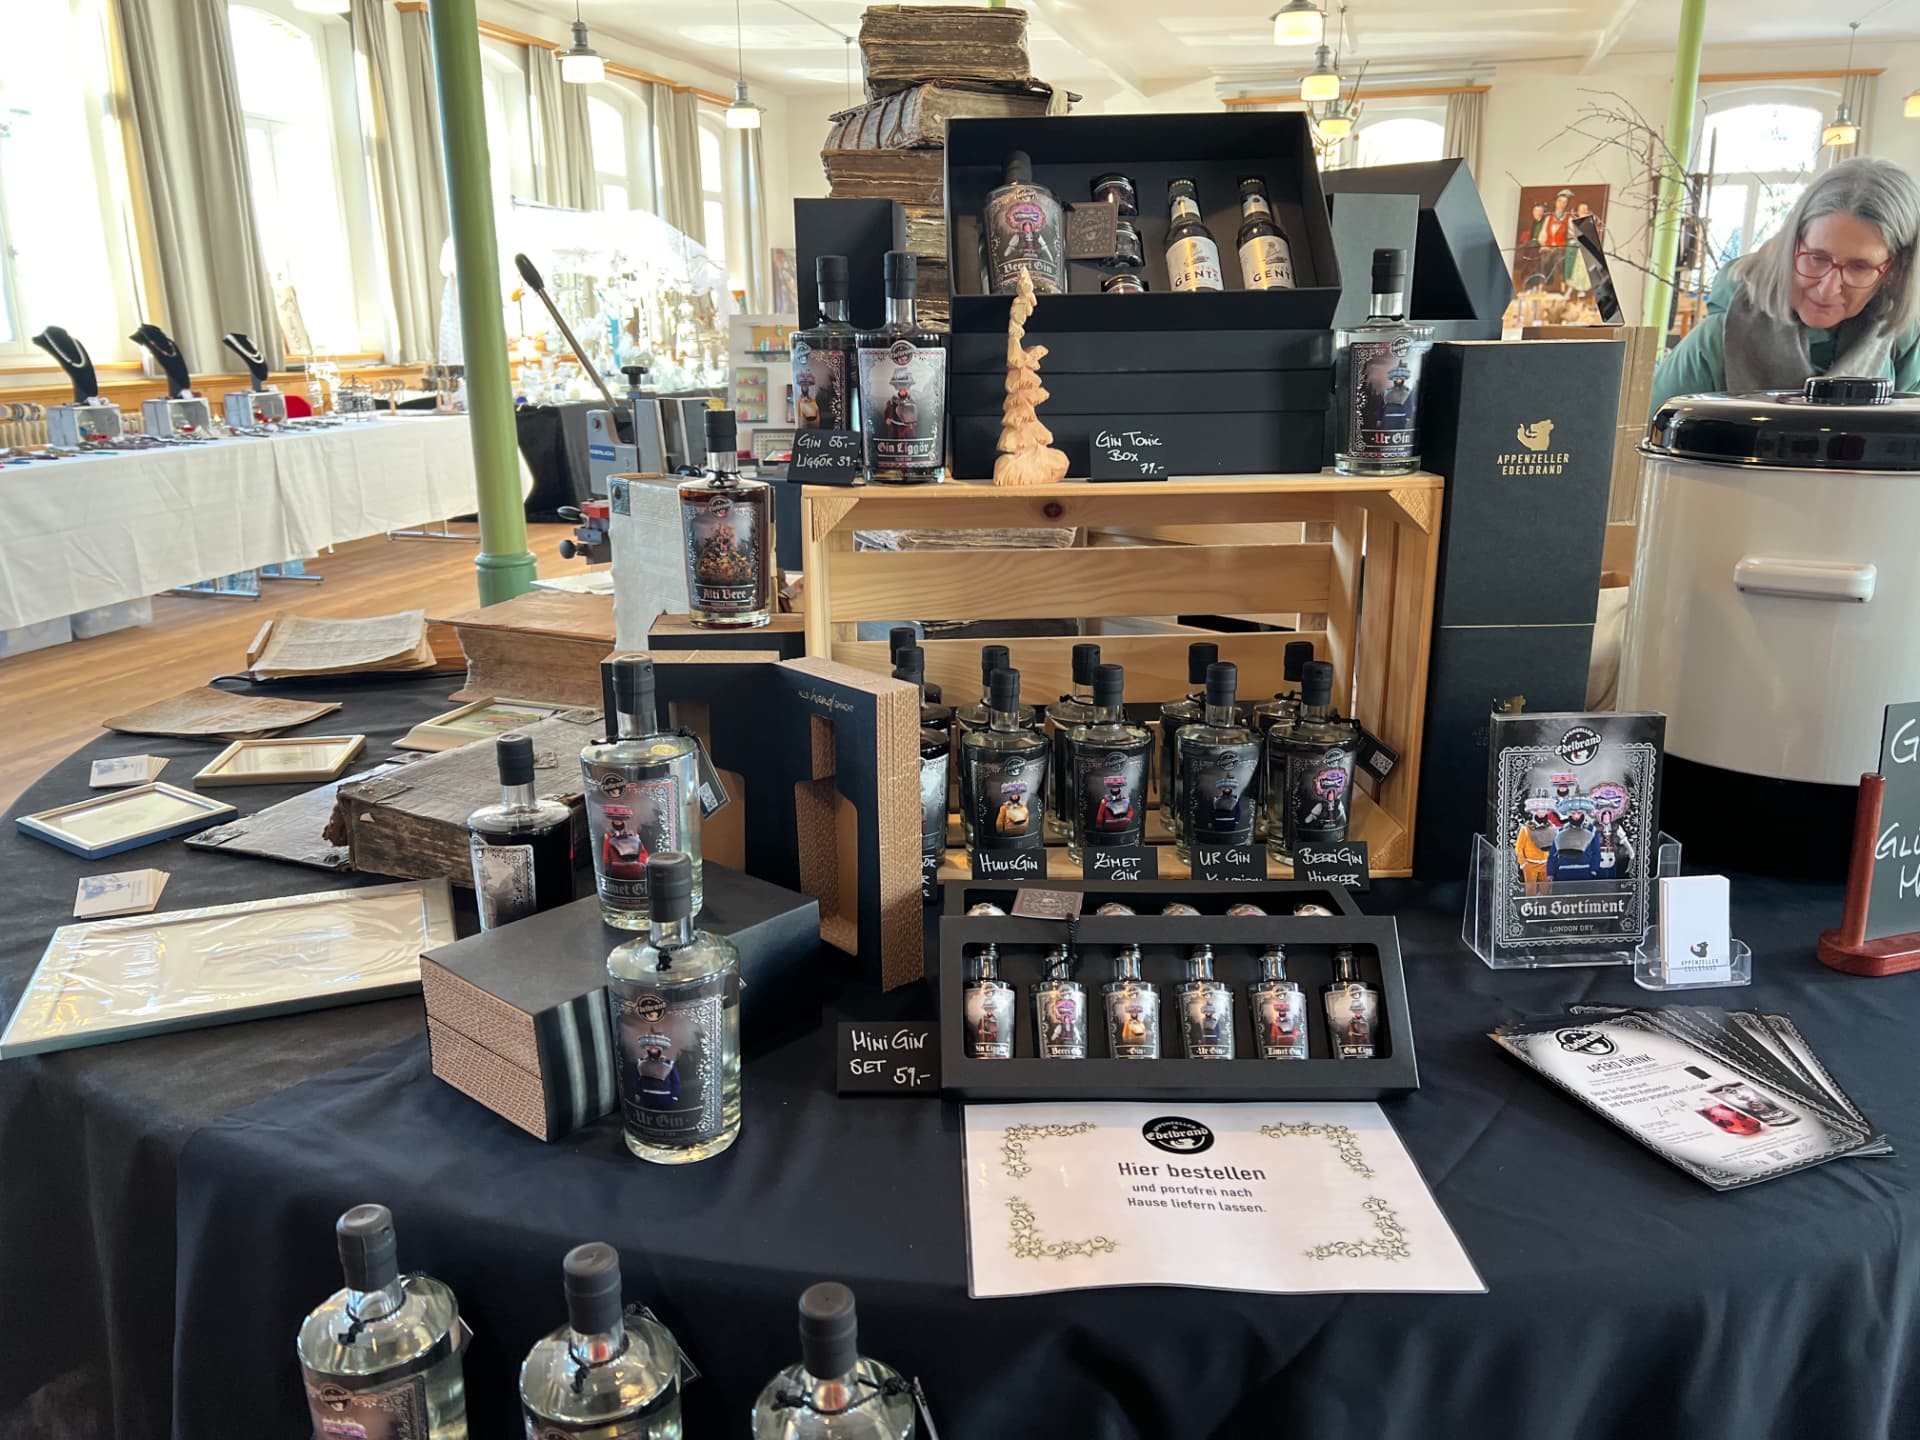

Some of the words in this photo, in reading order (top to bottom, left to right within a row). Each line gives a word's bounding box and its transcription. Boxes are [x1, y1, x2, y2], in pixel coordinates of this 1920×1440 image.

[1033, 261, 1053, 273] Gin
[1253, 269, 1295, 283] GENT
[877, 442, 895, 454] Gin
[897, 442, 929, 455] Liggör
[1496, 452, 1570, 465] APPENZELLER
[1502, 464, 1563, 476] EDELBRAND
[1554, 733, 1603, 755] Edelbrand
[631, 882, 648, 896] Gi
[1520, 901, 1547, 917] Gin
[1550, 898, 1625, 915] Sortiment
[1549, 924, 1579, 933] LONDON
[1579, 924, 1594, 932] DRY
[655, 1113, 684, 1129] Gin
[1145, 1126, 1209, 1141] Edelbrand
[1118, 1162, 1160, 1176] Hier
[1167, 1163, 1267, 1181] bestellen
[1132, 1183, 1157, 1193] und
[1160, 1184, 1217, 1196] portofrei
[1221, 1187, 1254, 1198] nach
[1127, 1197, 1168, 1208] Hause
[1171, 1198, 1216, 1211] liefern
[1219, 1201, 1268, 1214] lassen.
